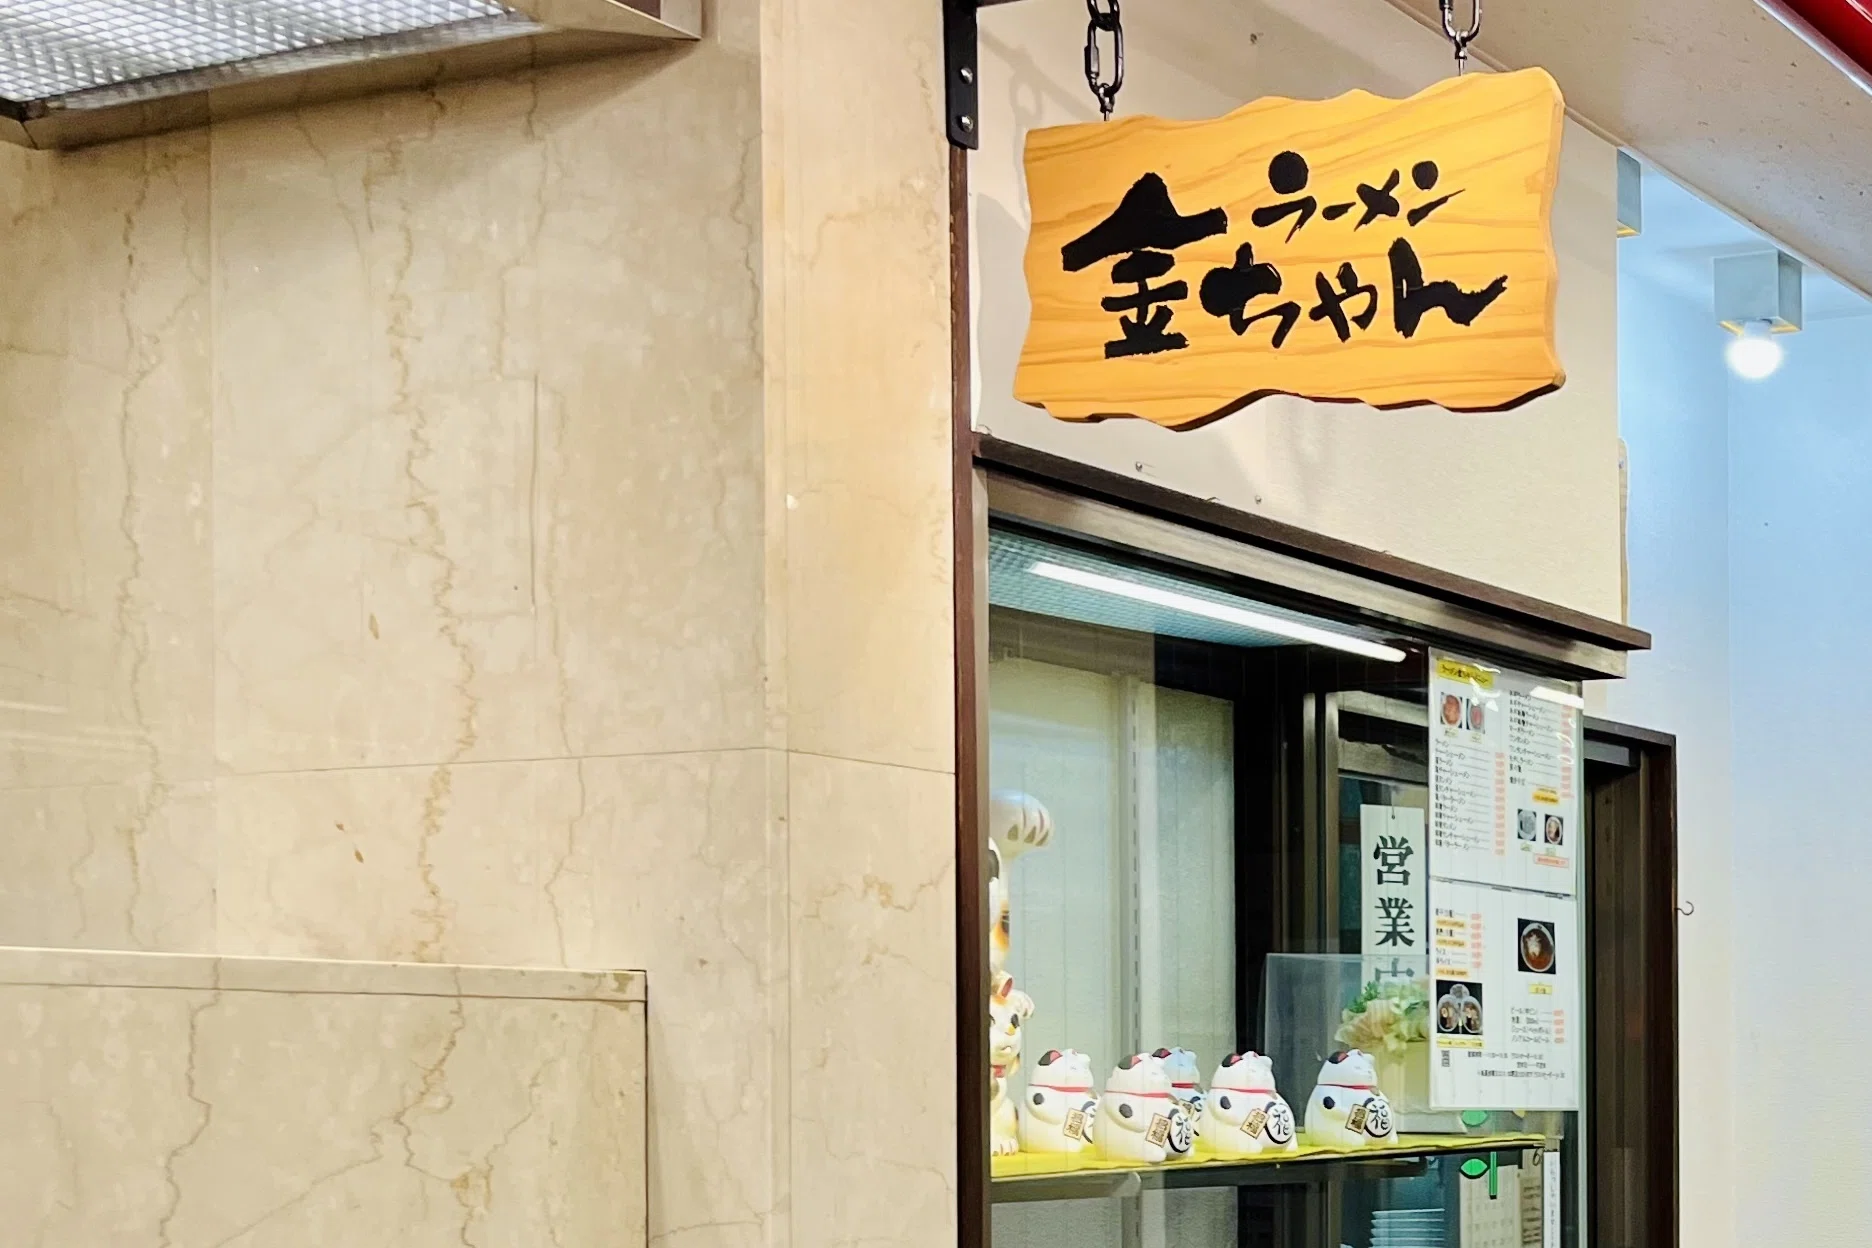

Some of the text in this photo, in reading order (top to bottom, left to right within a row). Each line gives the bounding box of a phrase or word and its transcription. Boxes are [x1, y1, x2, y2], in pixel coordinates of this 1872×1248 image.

[1061, 171, 1508, 360] 金ちゃん
[1252, 150, 1465, 243] ラーメン
